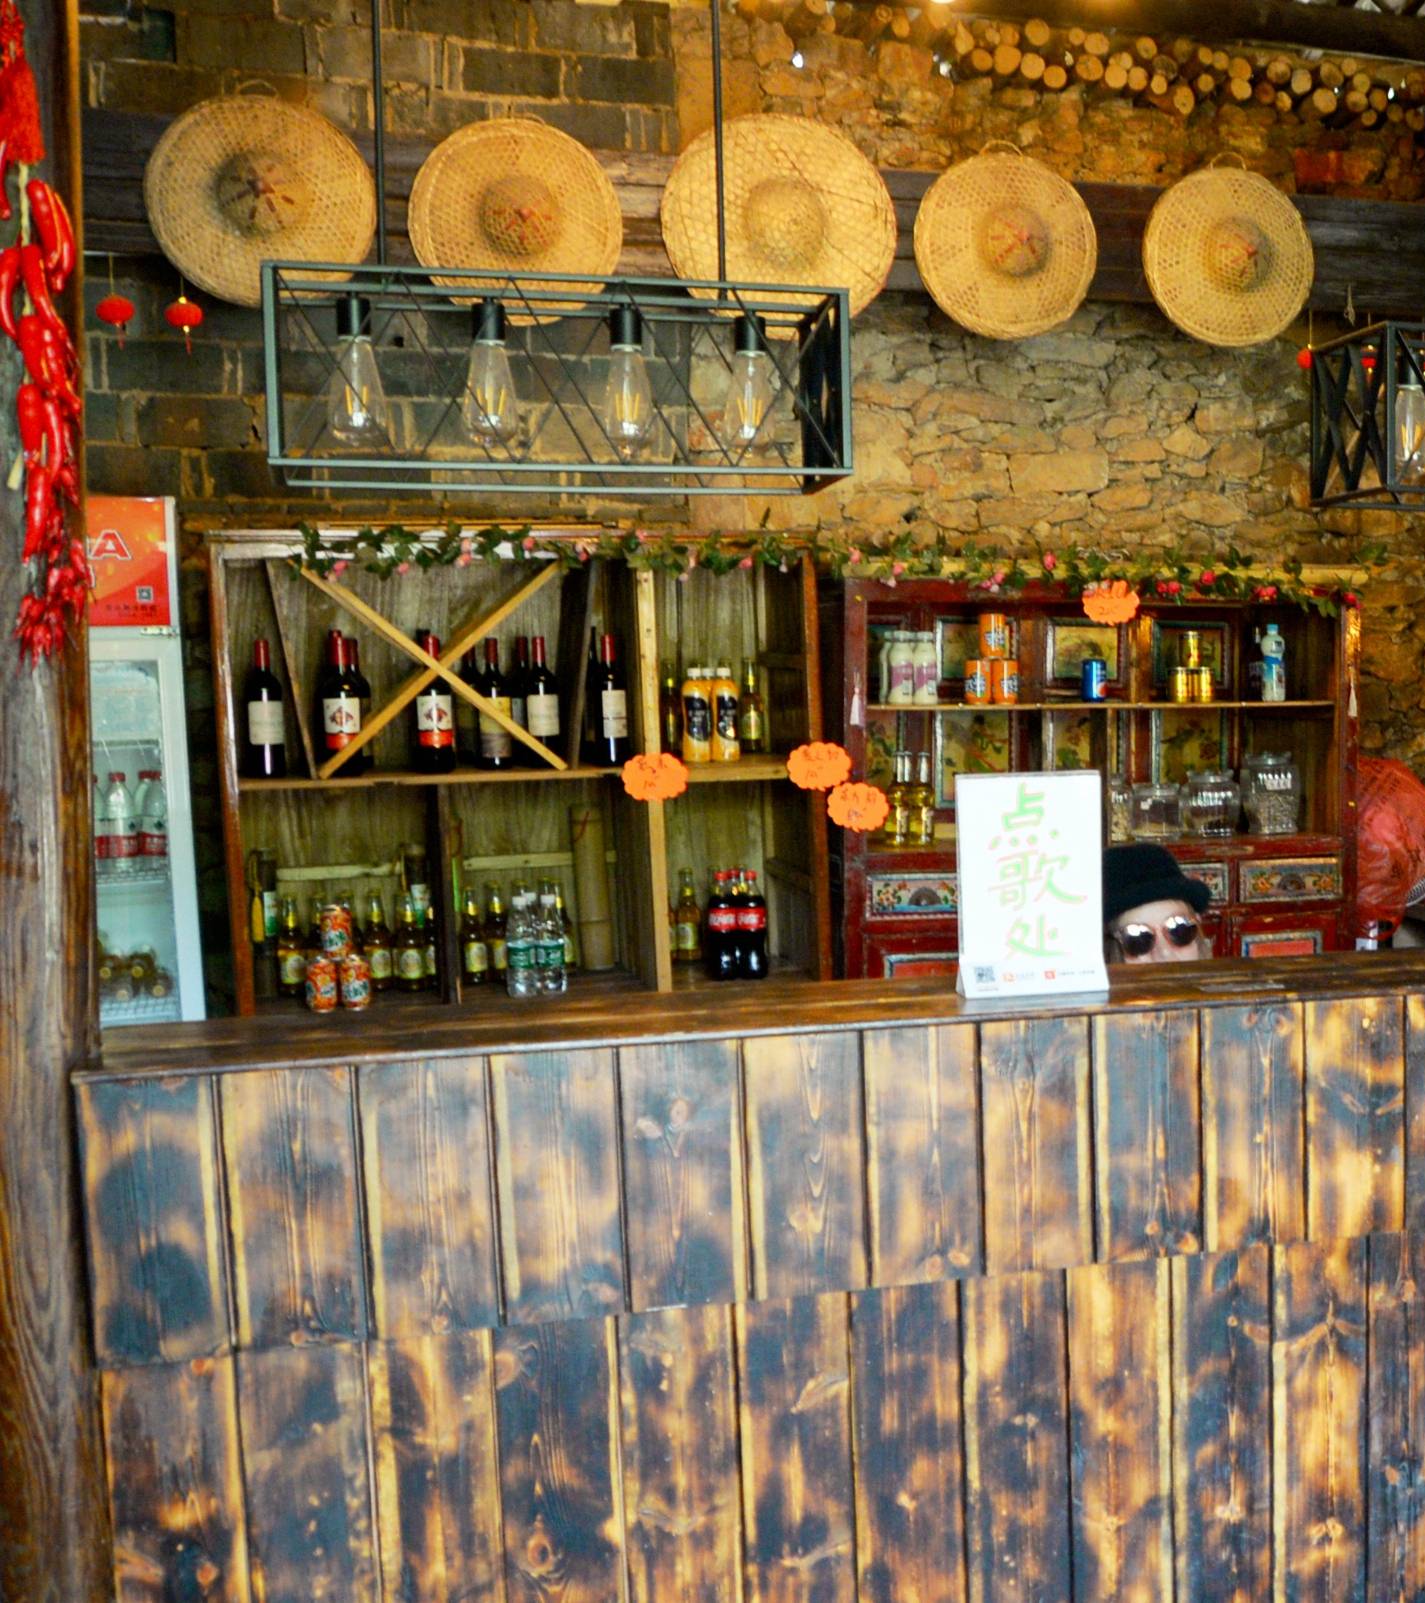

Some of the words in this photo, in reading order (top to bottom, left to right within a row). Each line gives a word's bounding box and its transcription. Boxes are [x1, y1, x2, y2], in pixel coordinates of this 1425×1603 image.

[87, 528, 132, 560] A
[988, 781, 1088, 961] 点歌处
